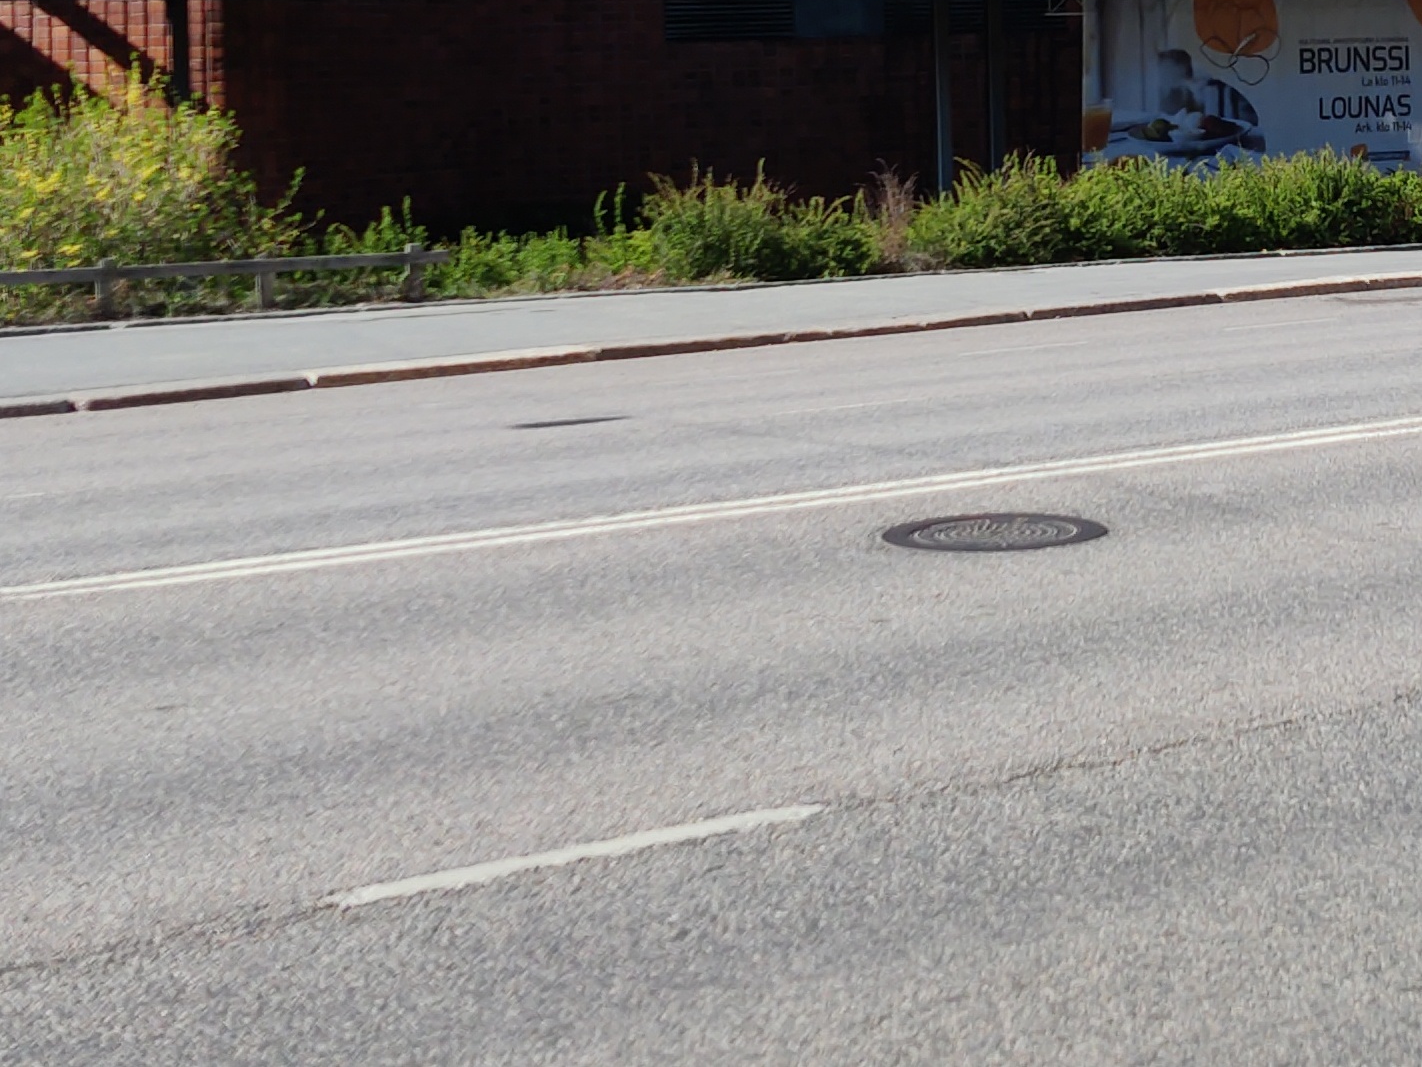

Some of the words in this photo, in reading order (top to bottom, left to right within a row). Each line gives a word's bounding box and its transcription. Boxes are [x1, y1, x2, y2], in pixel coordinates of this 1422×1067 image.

[1299, 45, 1410, 74] BRUNSSI
[1375, 75, 1389, 87] klo
[1391, 75, 1411, 86] 11-14
[1318, 94, 1412, 120] LOUNAS
[1376, 122, 1390, 132] klo
[1392, 121, 1412, 132] 11-14
